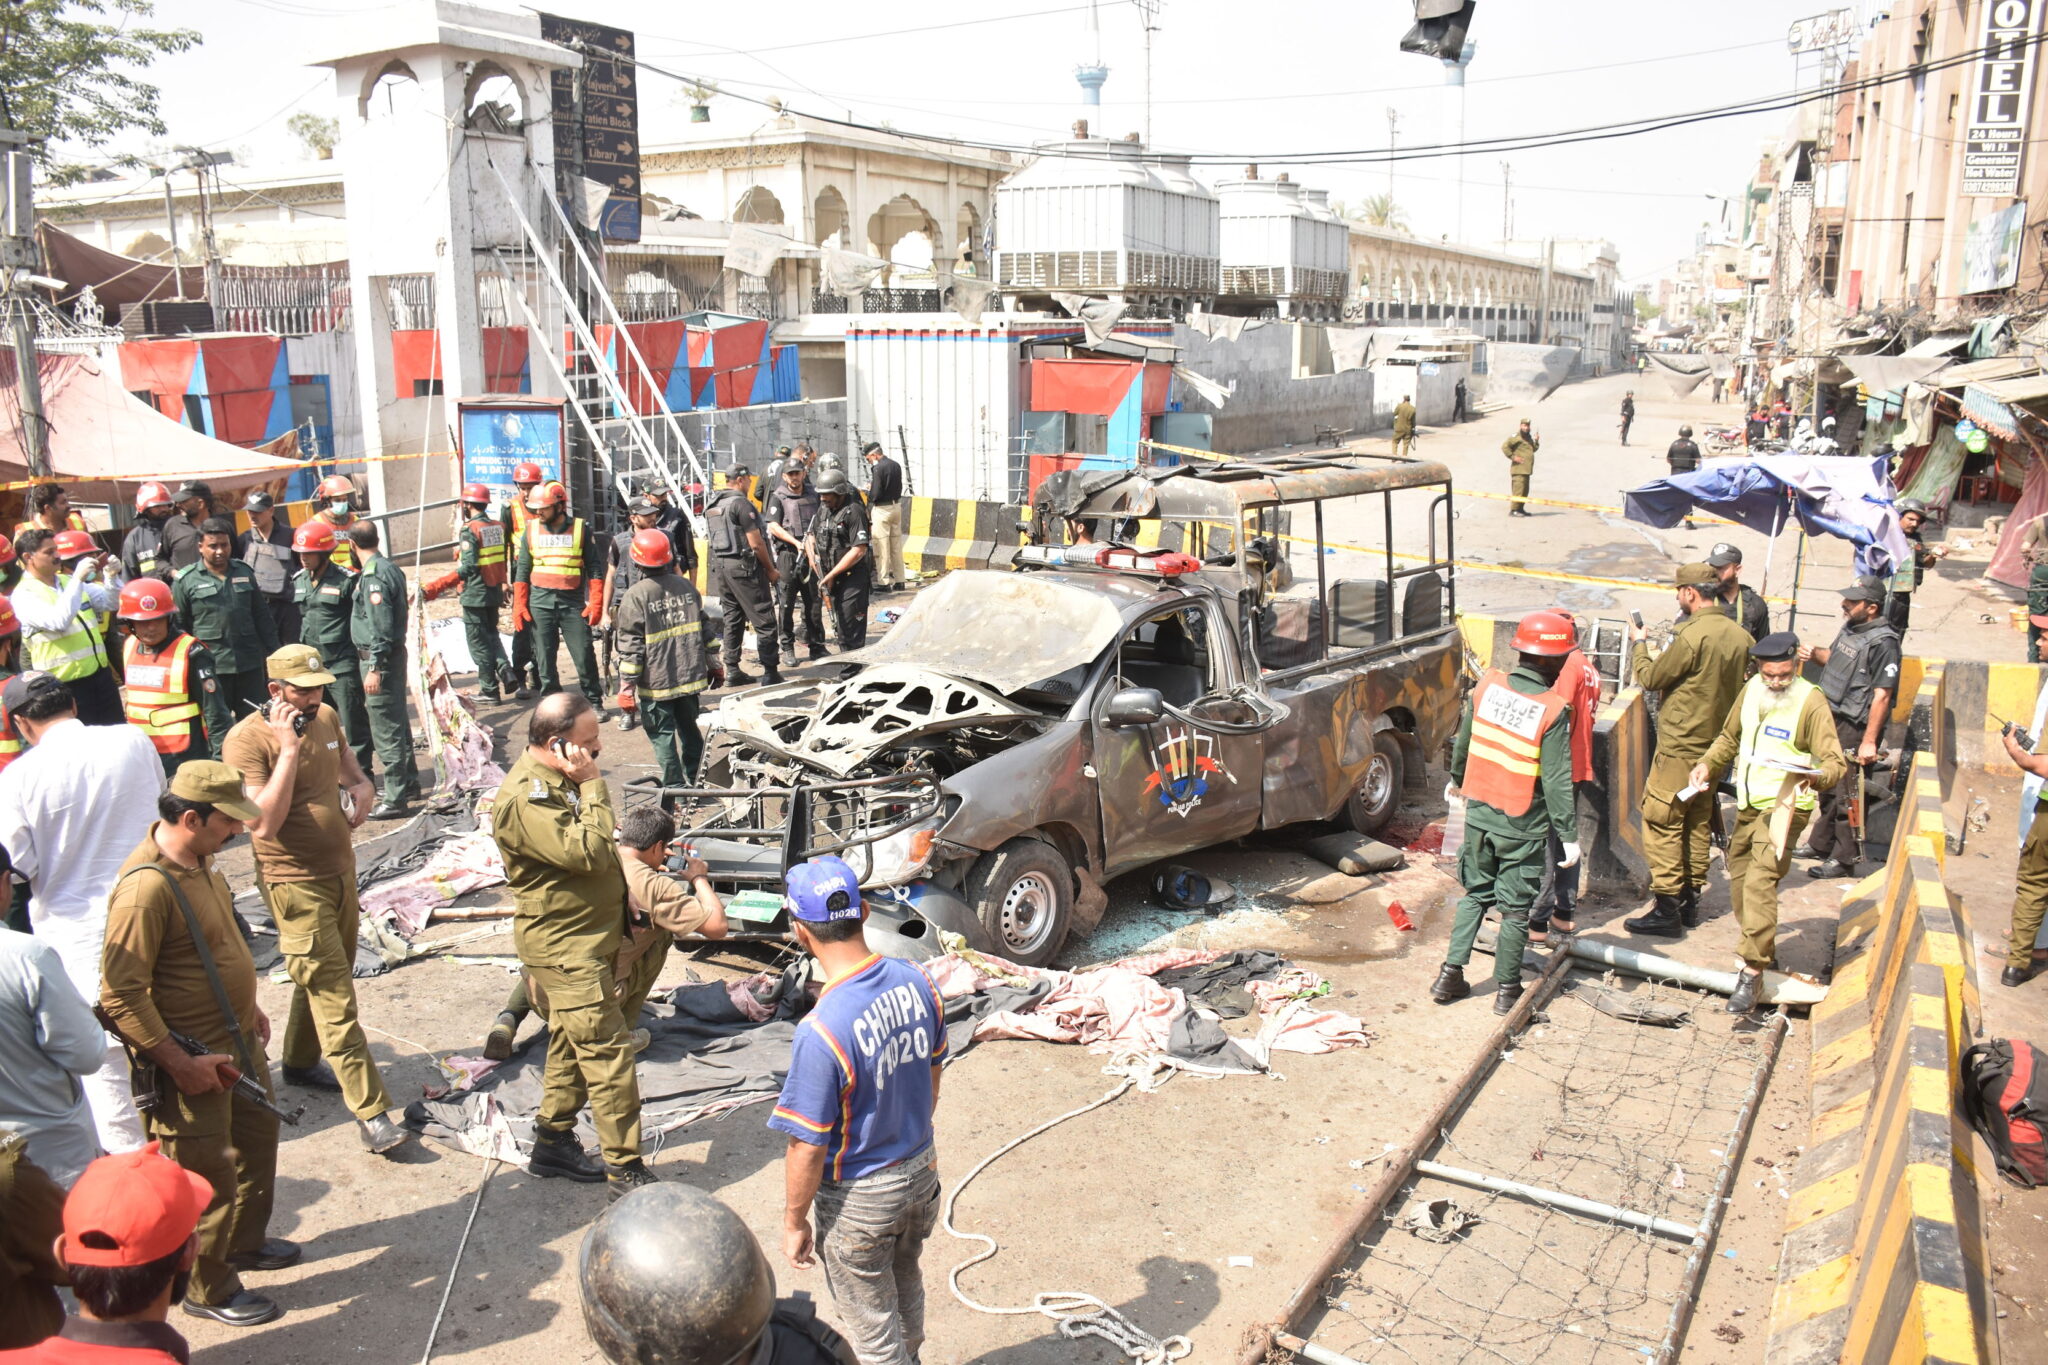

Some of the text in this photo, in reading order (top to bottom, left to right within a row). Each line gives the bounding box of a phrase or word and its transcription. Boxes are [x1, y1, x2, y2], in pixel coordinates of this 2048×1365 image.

[609, 115, 633, 129] Block
[1971, 129, 2018, 139] 24 Hours
[588, 148, 618, 162] Library
[1966, 154, 2016, 165] Generator
[1964, 168, 2015, 178] Hot Water
[489, 465, 513, 475] DATA
[648, 593, 694, 614] RESCUE
[662, 610, 686, 625] 1122
[1540, 633, 1568, 641] RESCUE
[1487, 688, 1539, 720] RESCUE
[1493, 708, 1522, 729] 1122
[814, 877, 847, 896] CHHIPA
[853, 982, 928, 1057] CHHIPA
